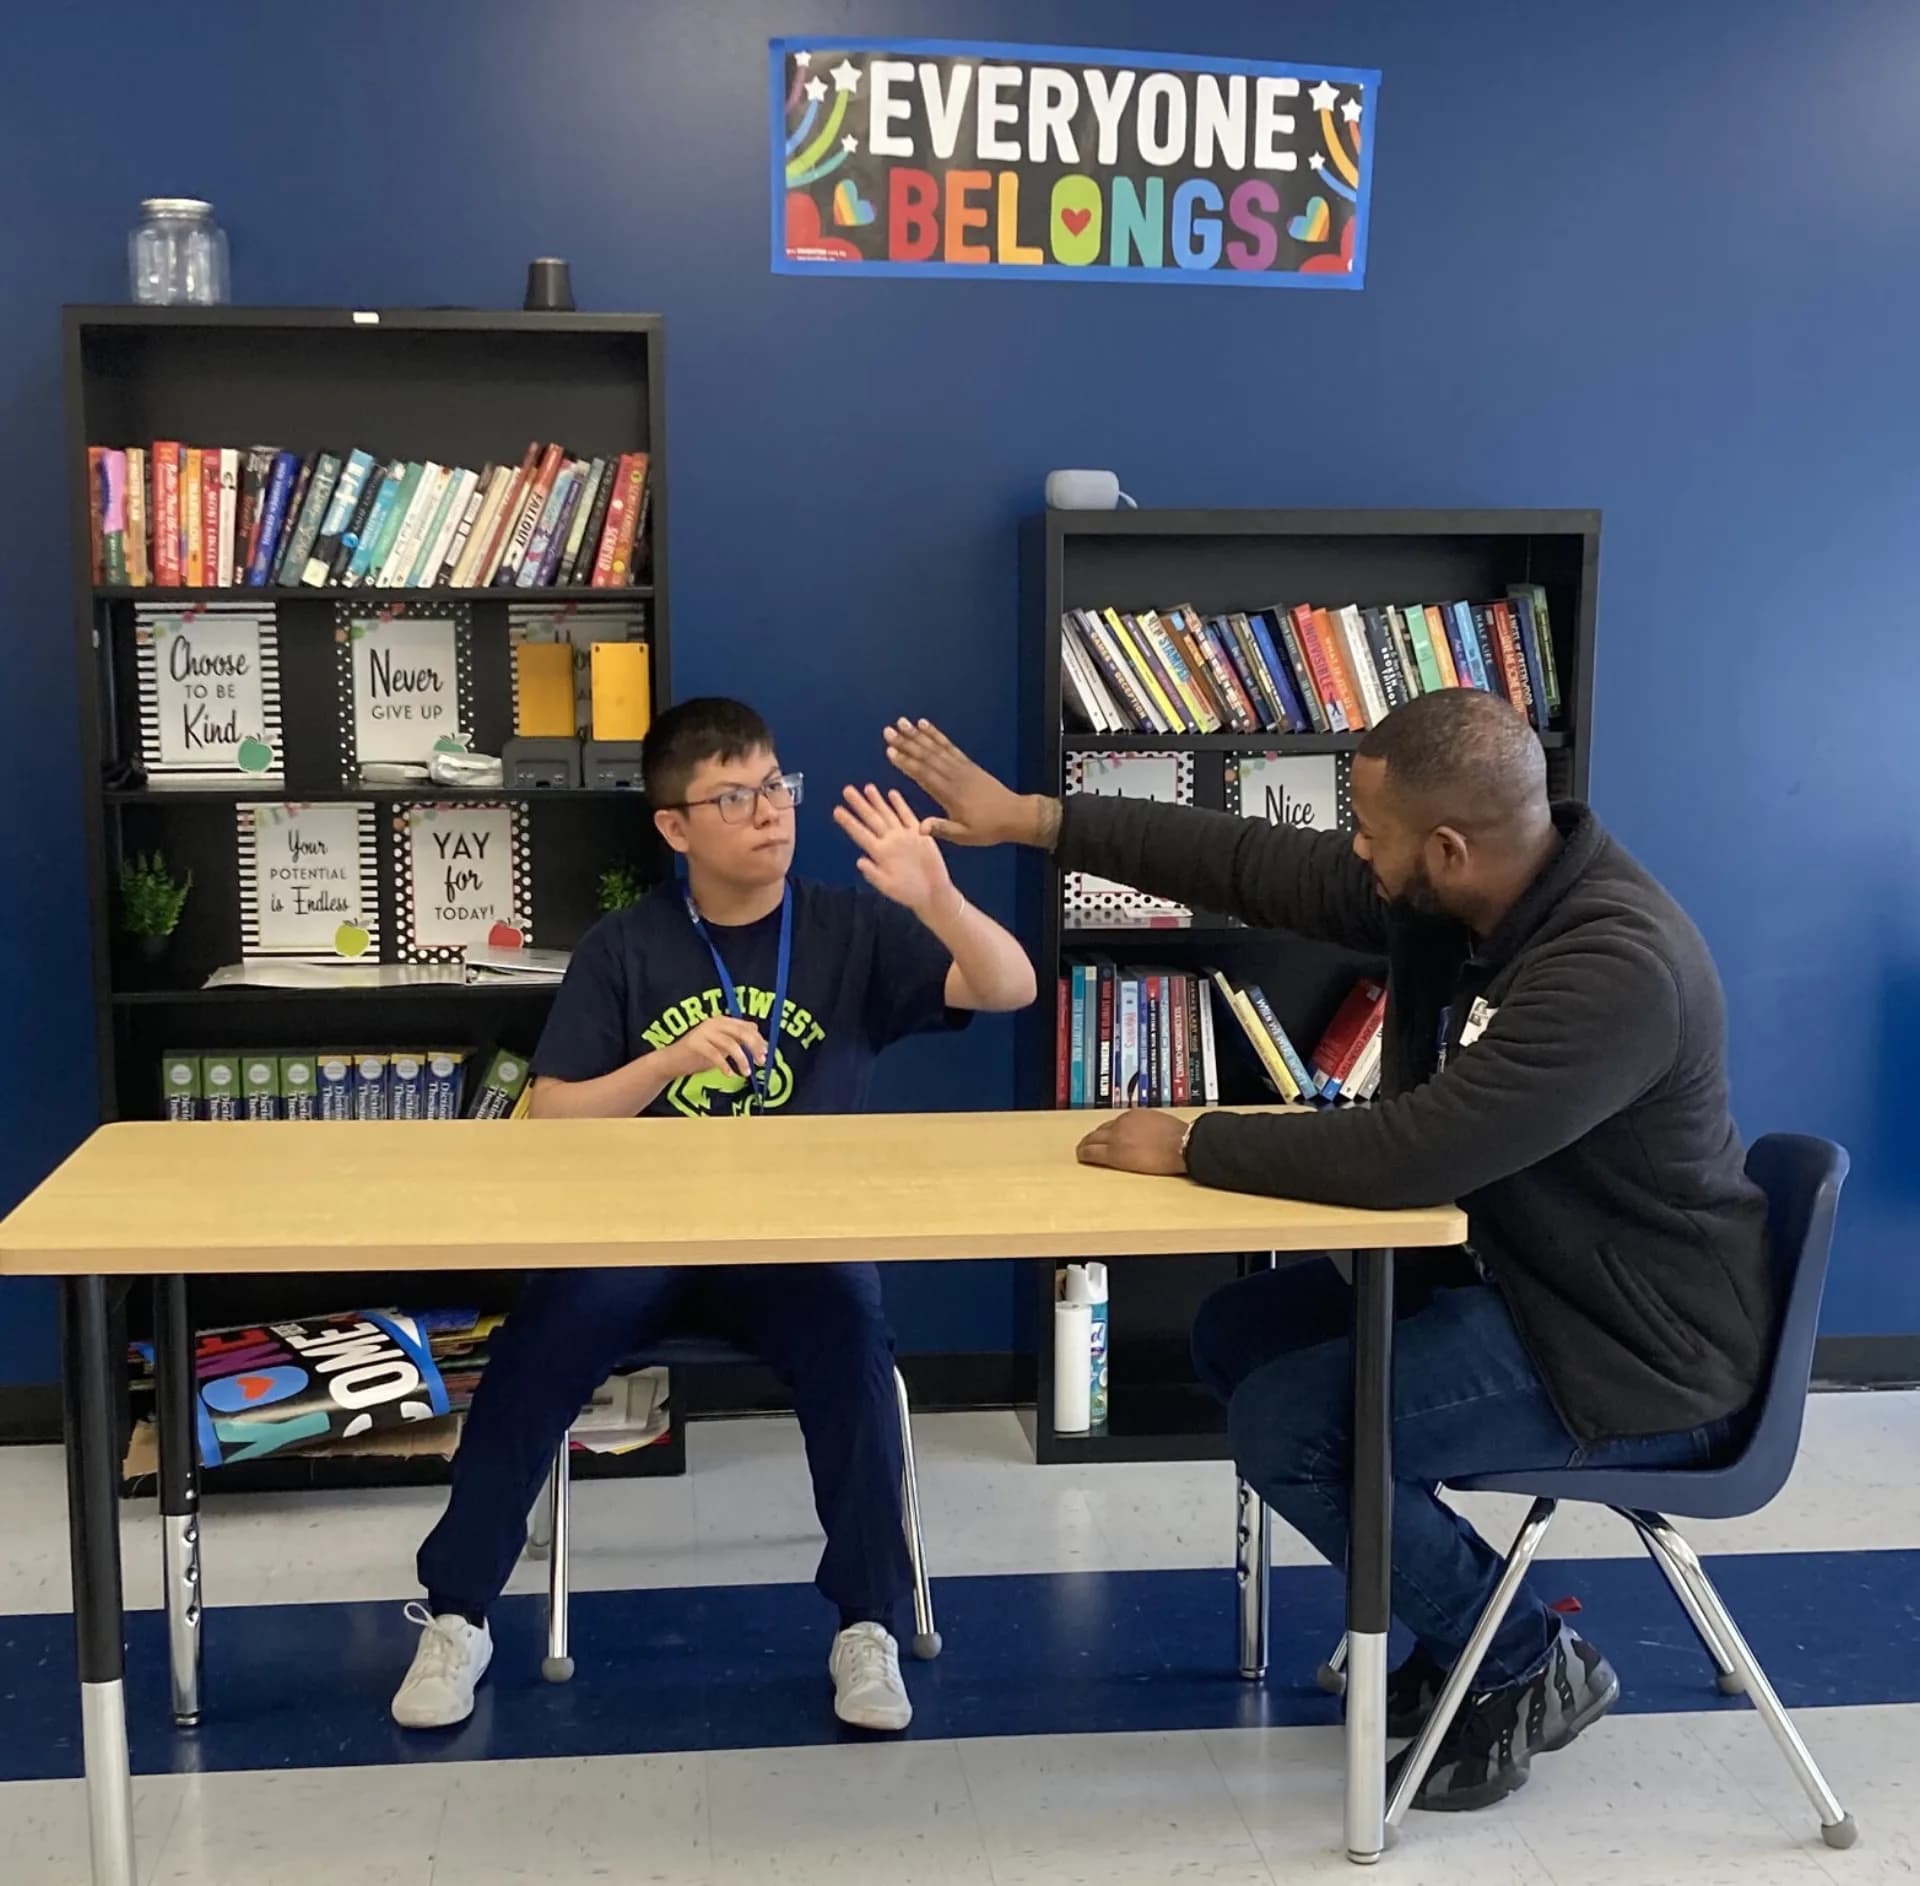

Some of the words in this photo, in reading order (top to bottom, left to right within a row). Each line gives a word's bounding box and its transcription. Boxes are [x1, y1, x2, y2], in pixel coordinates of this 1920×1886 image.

[868, 61, 1300, 171] EVERYONE
[888, 167, 1279, 271] BELONGS
[511, 491, 546, 548] FALLOUT
[207, 527, 217, 566] LIKELY
[169, 635, 247, 682] Choose
[1302, 621, 1334, 691] INDIVISIBLE
[1474, 613, 1487, 639] HALF
[1481, 642, 1493, 665] LIFE
[1507, 612, 1521, 641] ANGEL
[1515, 651, 1533, 705] GREENWOOD
[369, 648, 444, 699] Never
[1089, 629, 1112, 663] GAMES
[1113, 669, 1147, 720] DECEPTION
[1379, 646, 1398, 687] BROKEN
[1380, 667, 1397, 706] THINGS
[184, 684, 208, 699] TO
[216, 684, 236, 699] BE
[183, 703, 241, 750] Kind
[371, 705, 413, 720] GIVE
[421, 705, 443, 720] UP
[1265, 784, 1315, 828] Nice
[287, 828, 329, 864] Your
[432, 832, 491, 860] YAY
[270, 867, 347, 880] POTENTIAL
[443, 866, 484, 904] for
[270, 894, 285, 912] is
[292, 886, 350, 916] Endless
[434, 904, 496, 921] TODAY!
[1255, 997, 1275, 1023] WHEN
